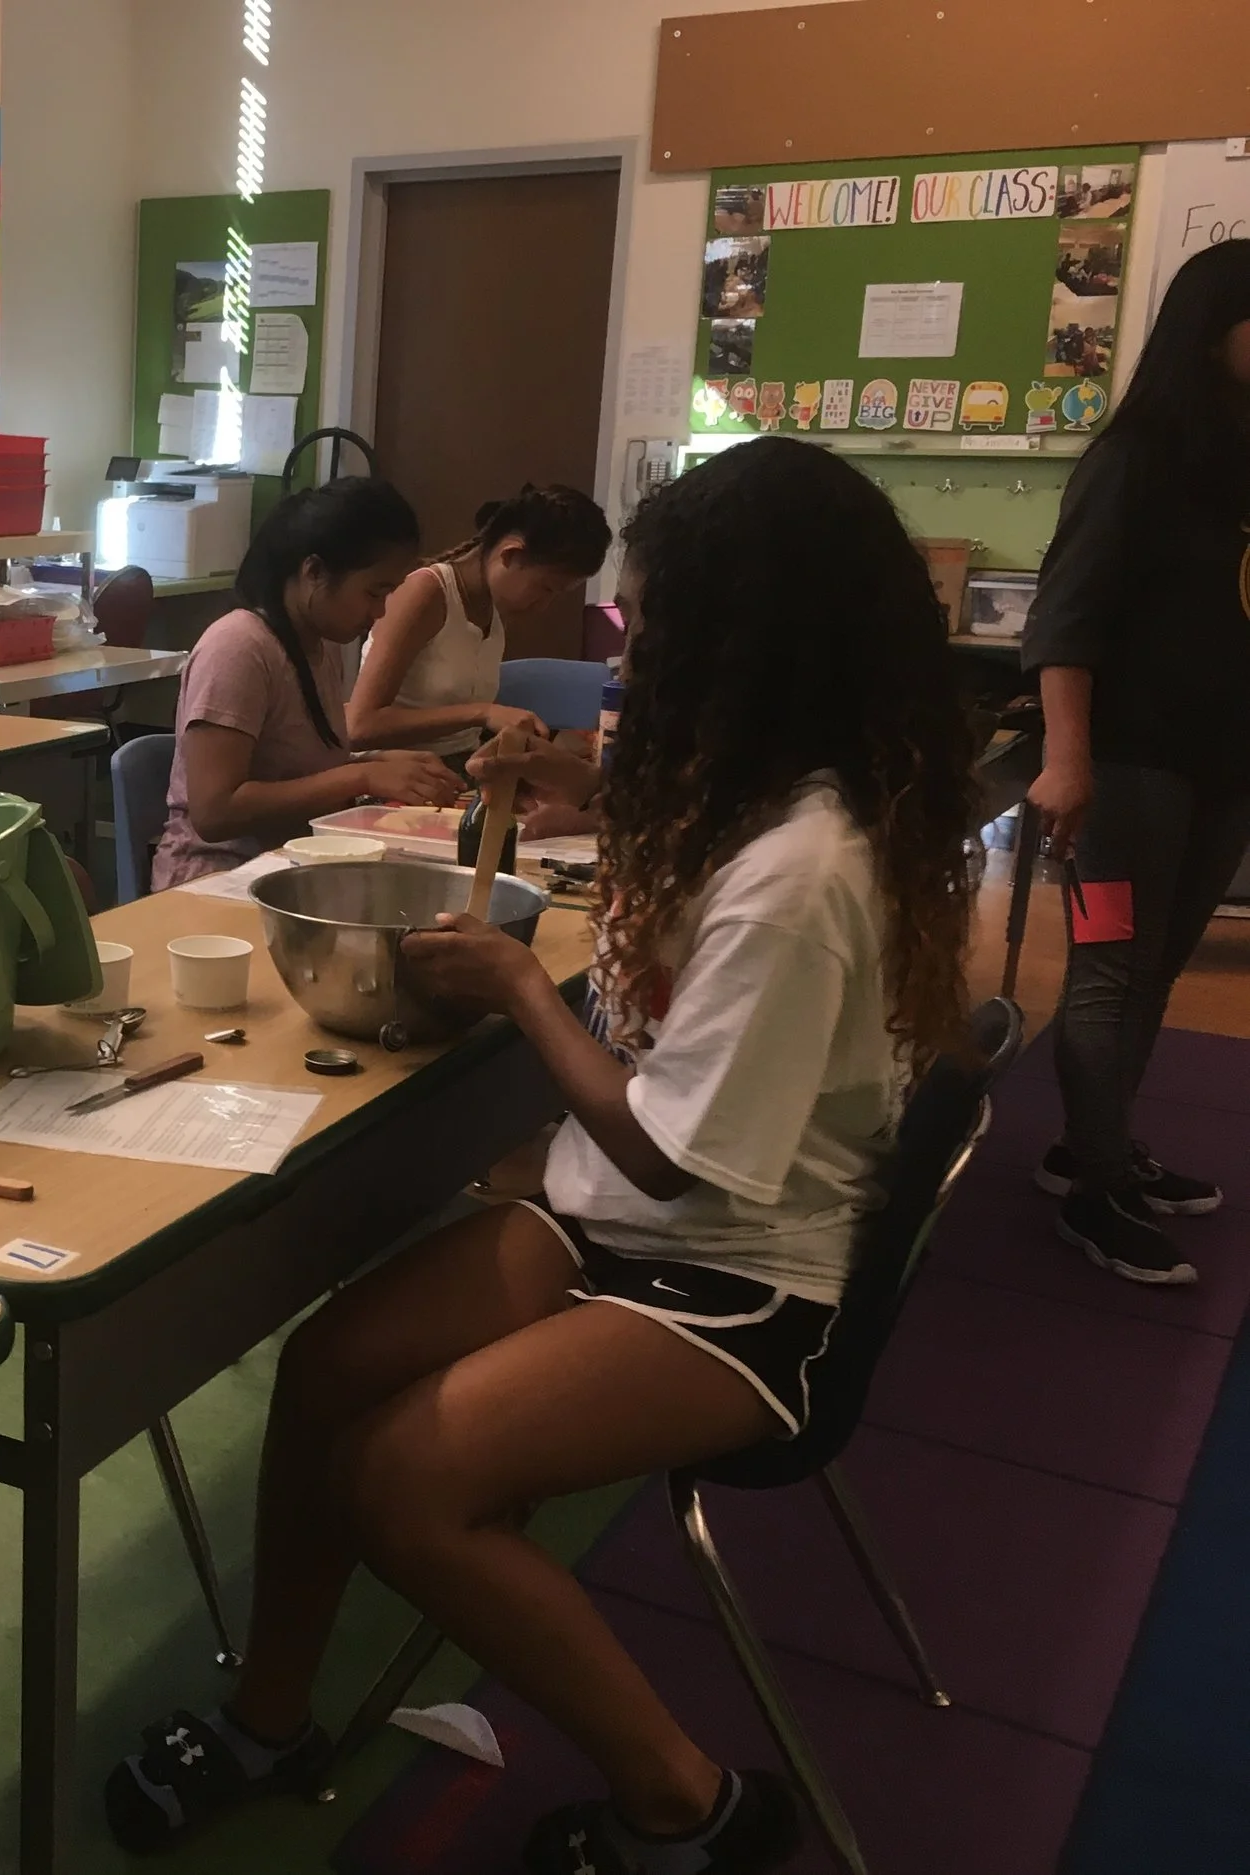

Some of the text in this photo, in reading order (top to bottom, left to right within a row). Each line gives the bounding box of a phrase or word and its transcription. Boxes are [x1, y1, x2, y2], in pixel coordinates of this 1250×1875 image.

[769, 178, 897, 228] WELCOME!
[914, 176, 960, 218] OUR
[911, 381, 956, 395] NEVER
[909, 395, 953, 409] GIVE
[860, 405, 894, 419] BIG
[908, 409, 952, 428] UP
[7, 1243, 67, 1269] 17
